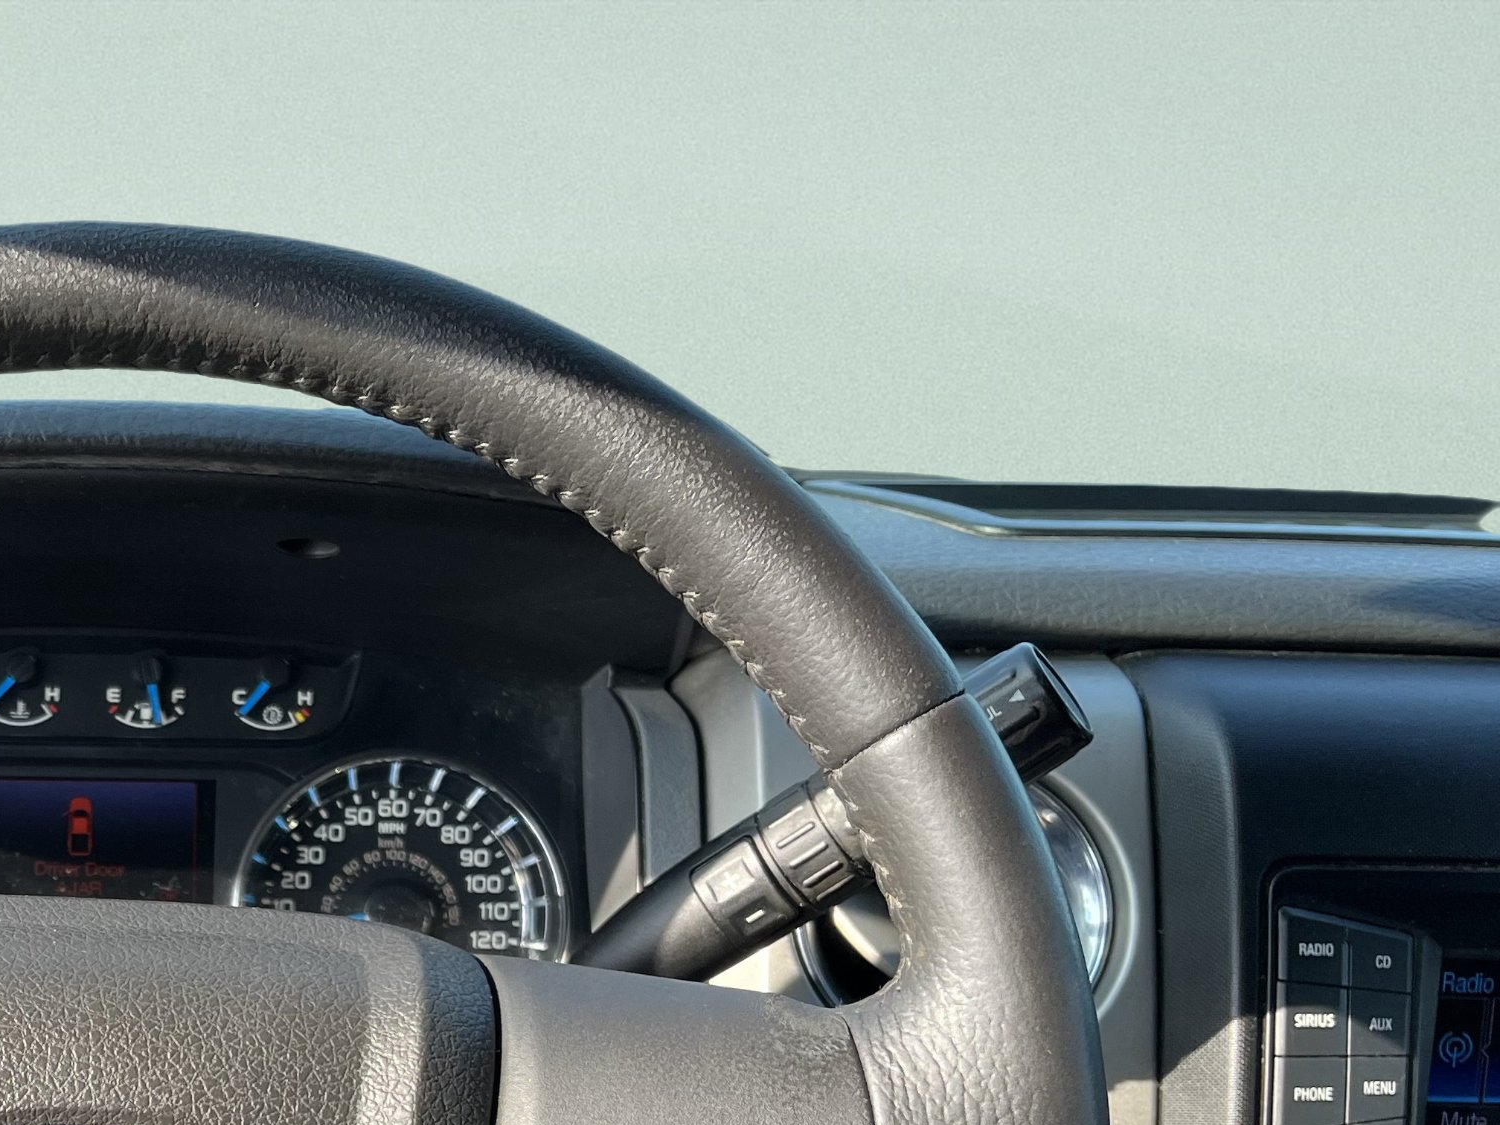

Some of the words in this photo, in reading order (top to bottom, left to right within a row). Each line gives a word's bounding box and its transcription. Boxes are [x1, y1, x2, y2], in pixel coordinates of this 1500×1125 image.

[44, 686, 61, 702] H
[106, 687, 121, 703] E
[171, 688, 186, 703] F
[231, 689, 248, 705] C
[297, 690, 314, 706] H
[344, 806, 375, 826] 50
[377, 799, 410, 818] 60
[414, 807, 443, 827] 70
[313, 823, 345, 842] 40
[377, 821, 407, 835] MPH
[440, 825, 473, 845] 80
[296, 846, 325, 865] 30
[459, 849, 491, 868] 90
[280, 871, 312, 890] 20
[465, 875, 504, 894] 100
[478, 903, 510, 921] 110
[469, 931, 507, 949] 120
[1298, 942, 1335, 957] RADIO
[1375, 955, 1391, 969] CD
[1442, 971, 1495, 993] Radio
[1294, 1013, 1336, 1029] SIRIUS
[1368, 1017, 1393, 1031] AUX
[1293, 1086, 1334, 1102] PHONE
[1363, 1080, 1397, 1097] MENU
